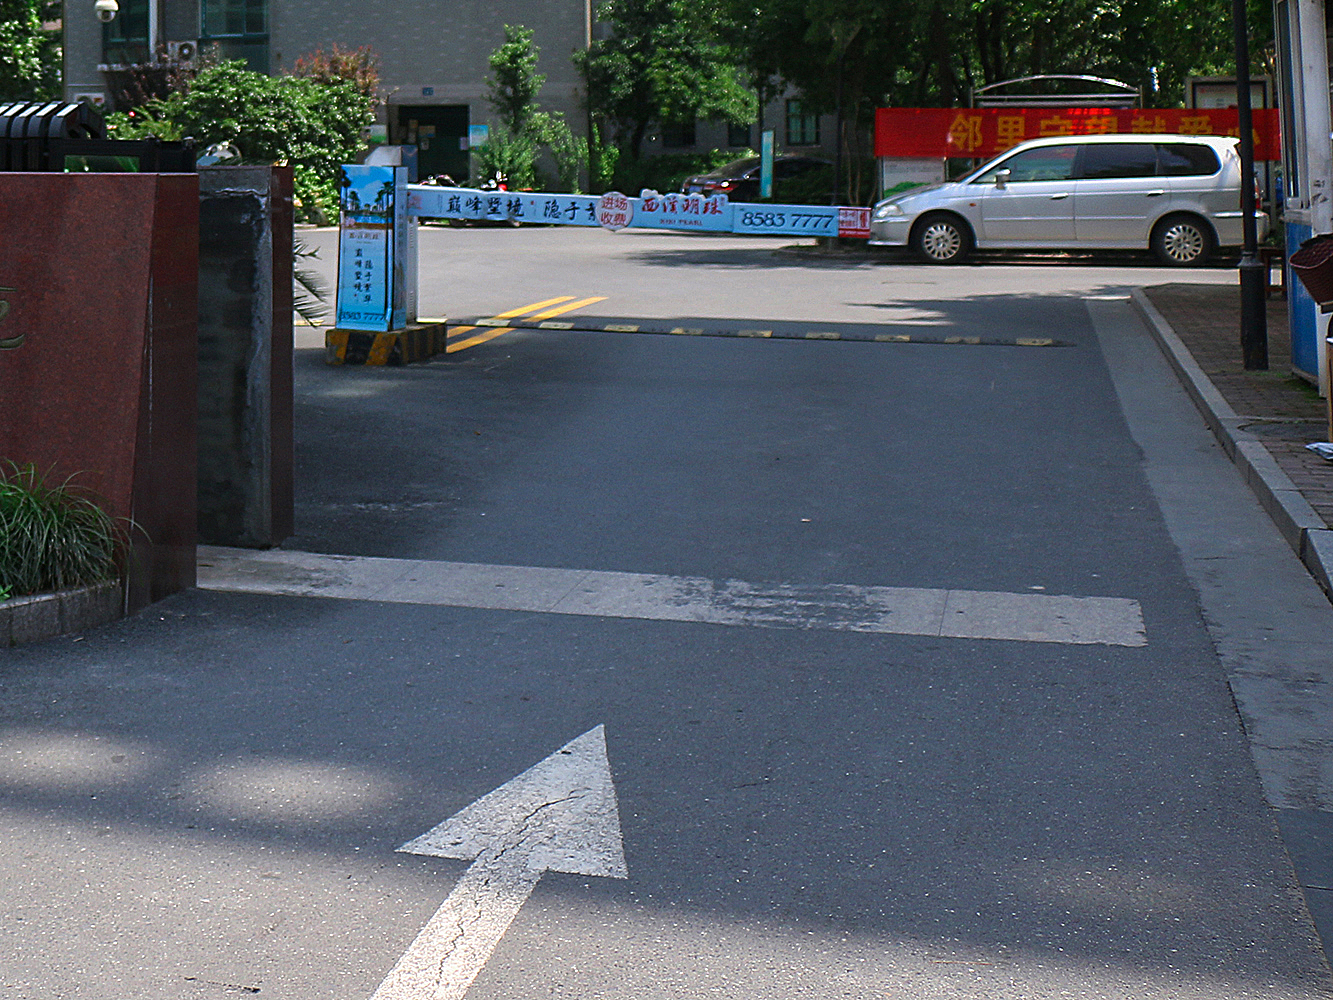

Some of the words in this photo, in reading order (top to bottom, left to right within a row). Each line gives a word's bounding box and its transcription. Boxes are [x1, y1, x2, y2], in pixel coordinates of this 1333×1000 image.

[446, 195, 525, 218] 巅峰墅境
[600, 196, 628, 211] 进场
[641, 197, 723, 215] 西溪明珠
[600, 211, 627, 226] 收费
[742, 211, 786, 228] 8583
[791, 213, 835, 229] 7777
